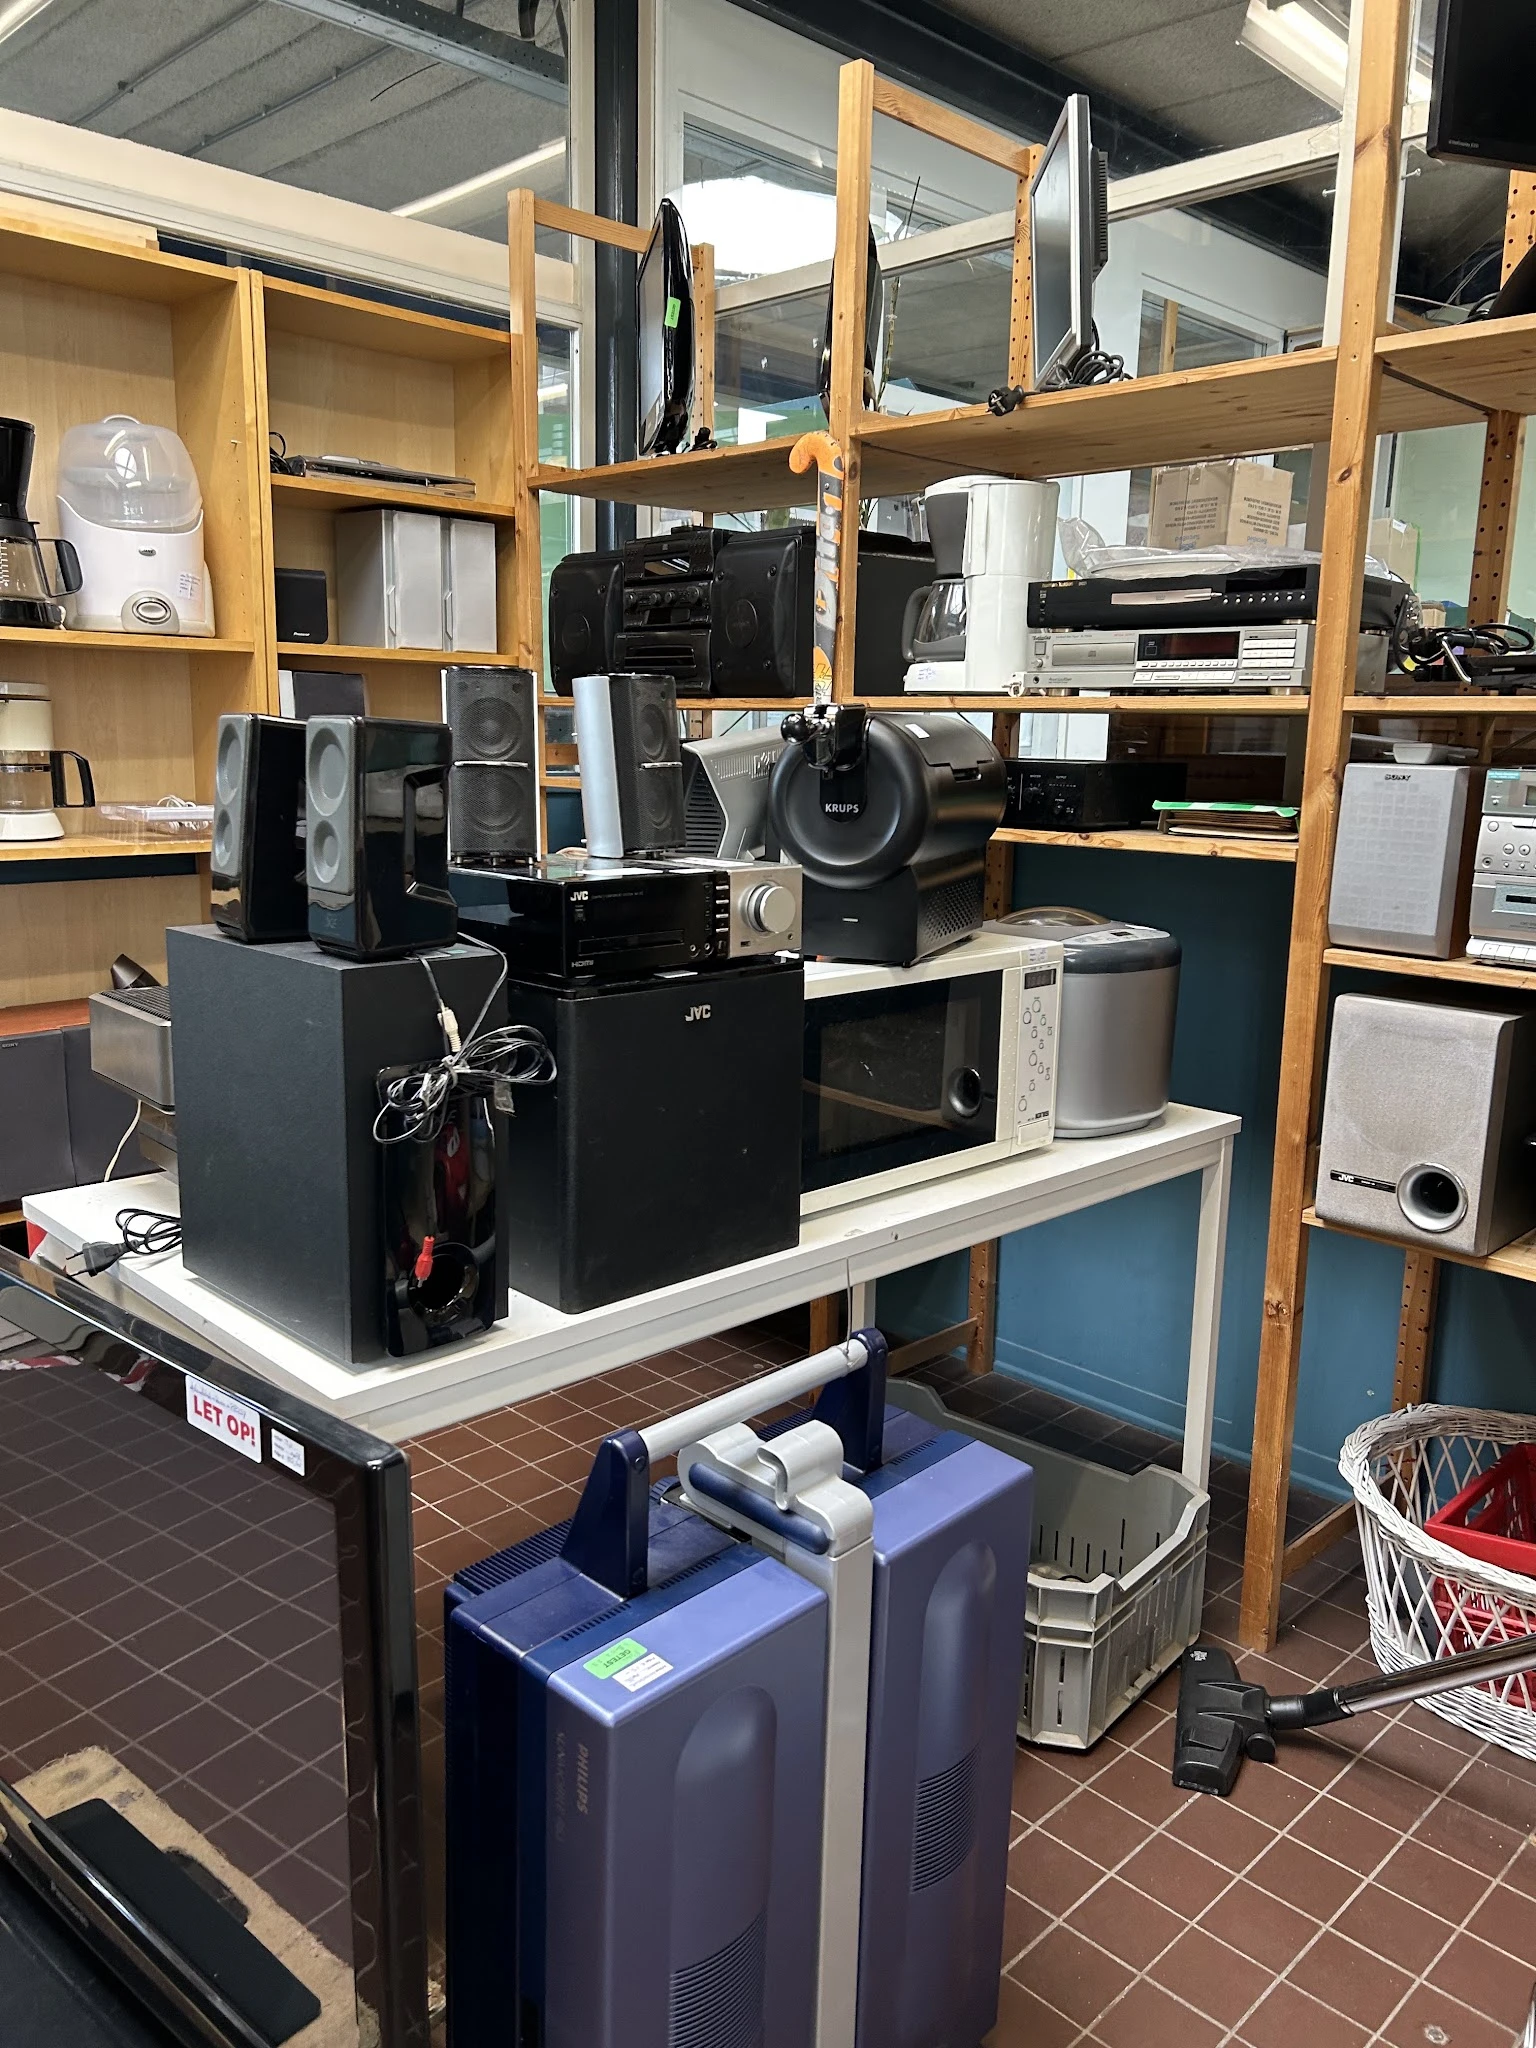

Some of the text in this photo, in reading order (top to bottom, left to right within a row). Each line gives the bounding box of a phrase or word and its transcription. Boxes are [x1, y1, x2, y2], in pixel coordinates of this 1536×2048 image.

[1384, 773, 1411, 782] SONY
[825, 803, 859, 814] KRUPS
[570, 890, 589, 901] JVC
[571, 959, 594, 967] HDMI
[685, 1004, 711, 1022] JVC
[1338, 1173, 1355, 1183] JVC
[193, 1394, 223, 1427] LET
[226, 1414, 256, 1447] OP!
[603, 1648, 631, 1668] GETEST
[577, 1742, 589, 1815] PHILIPS
